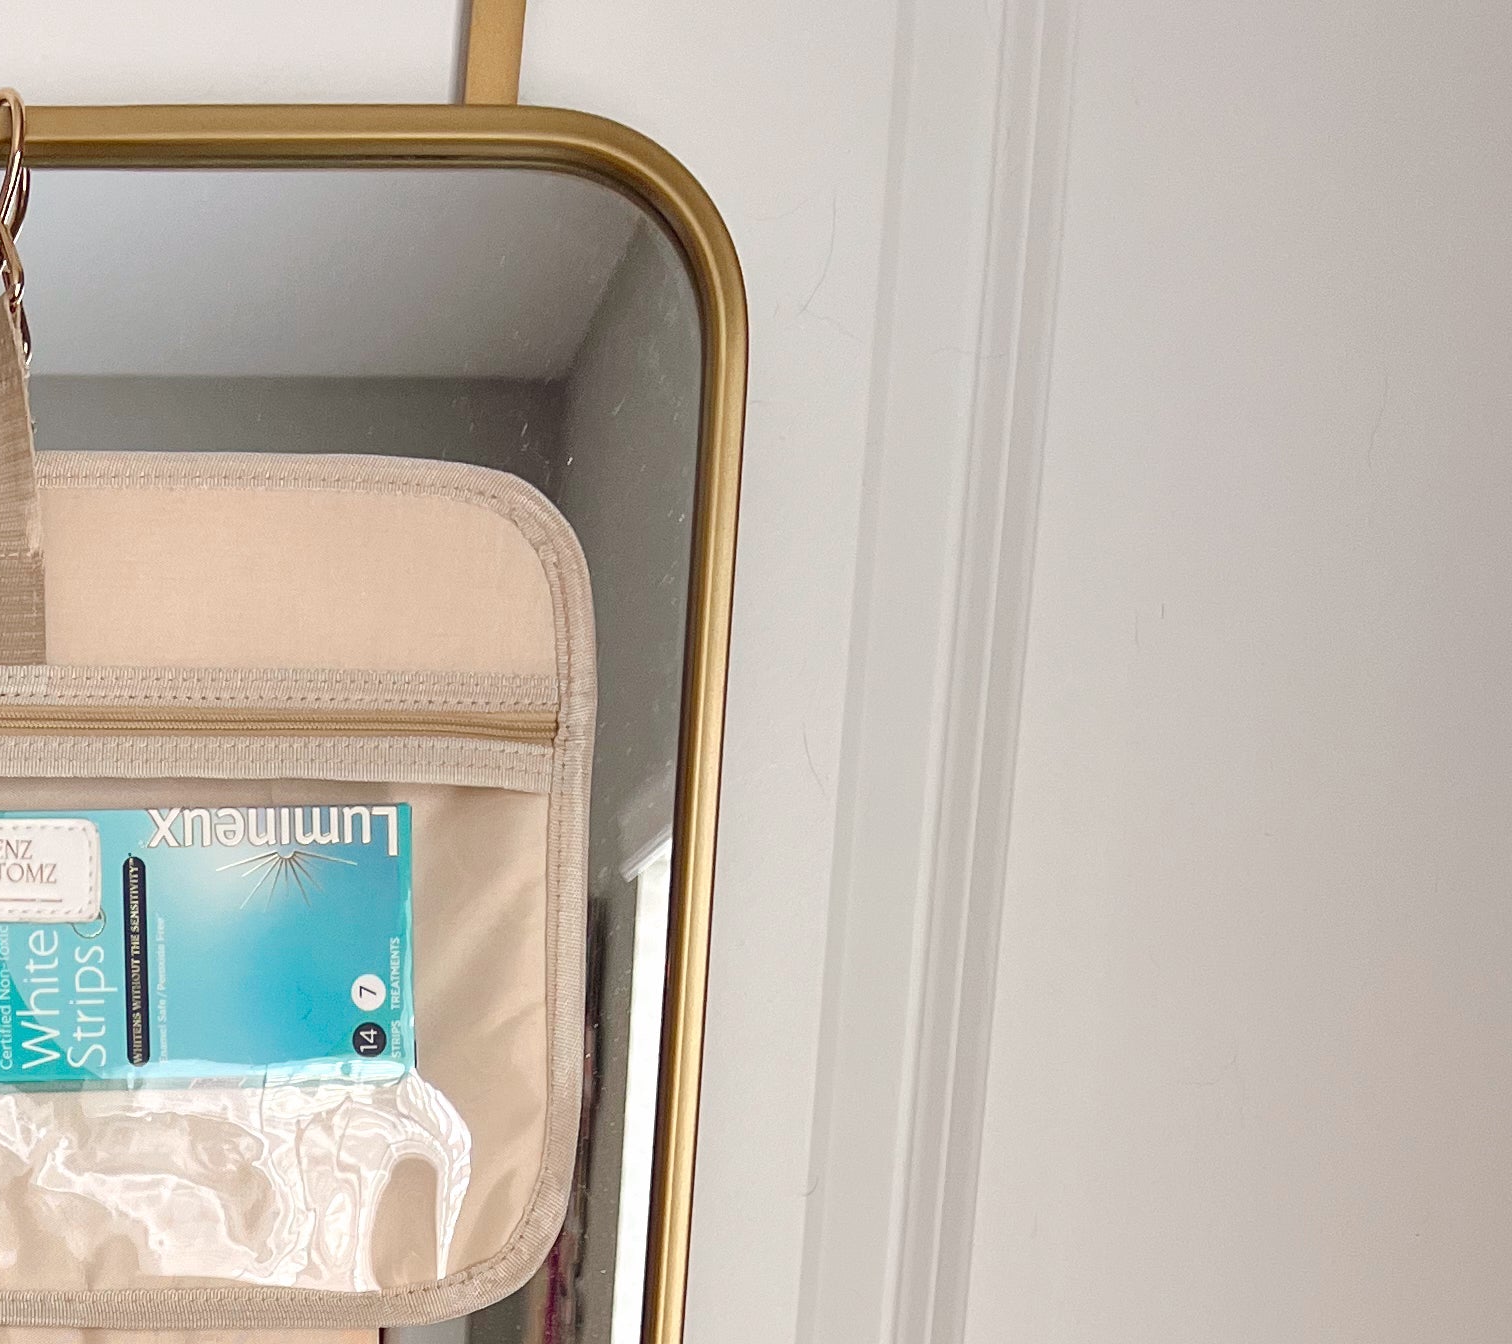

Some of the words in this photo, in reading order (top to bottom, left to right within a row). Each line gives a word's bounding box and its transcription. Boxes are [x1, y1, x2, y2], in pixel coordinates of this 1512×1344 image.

[146, 805, 399, 857] Lumineux
[131, 934, 141, 957] THE
[131, 958, 142, 1012] WITHOUT
[359, 985, 377, 999] 7
[389, 935, 401, 1011] TREATMENTS
[15, 929, 61, 1070] White
[66, 945, 118, 1068] Strips
[157, 998, 168, 1023] Safe
[131, 1012, 143, 1065] WHITENS
[359, 1028, 378, 1053] 14
[391, 1020, 402, 1059] STRIPS
